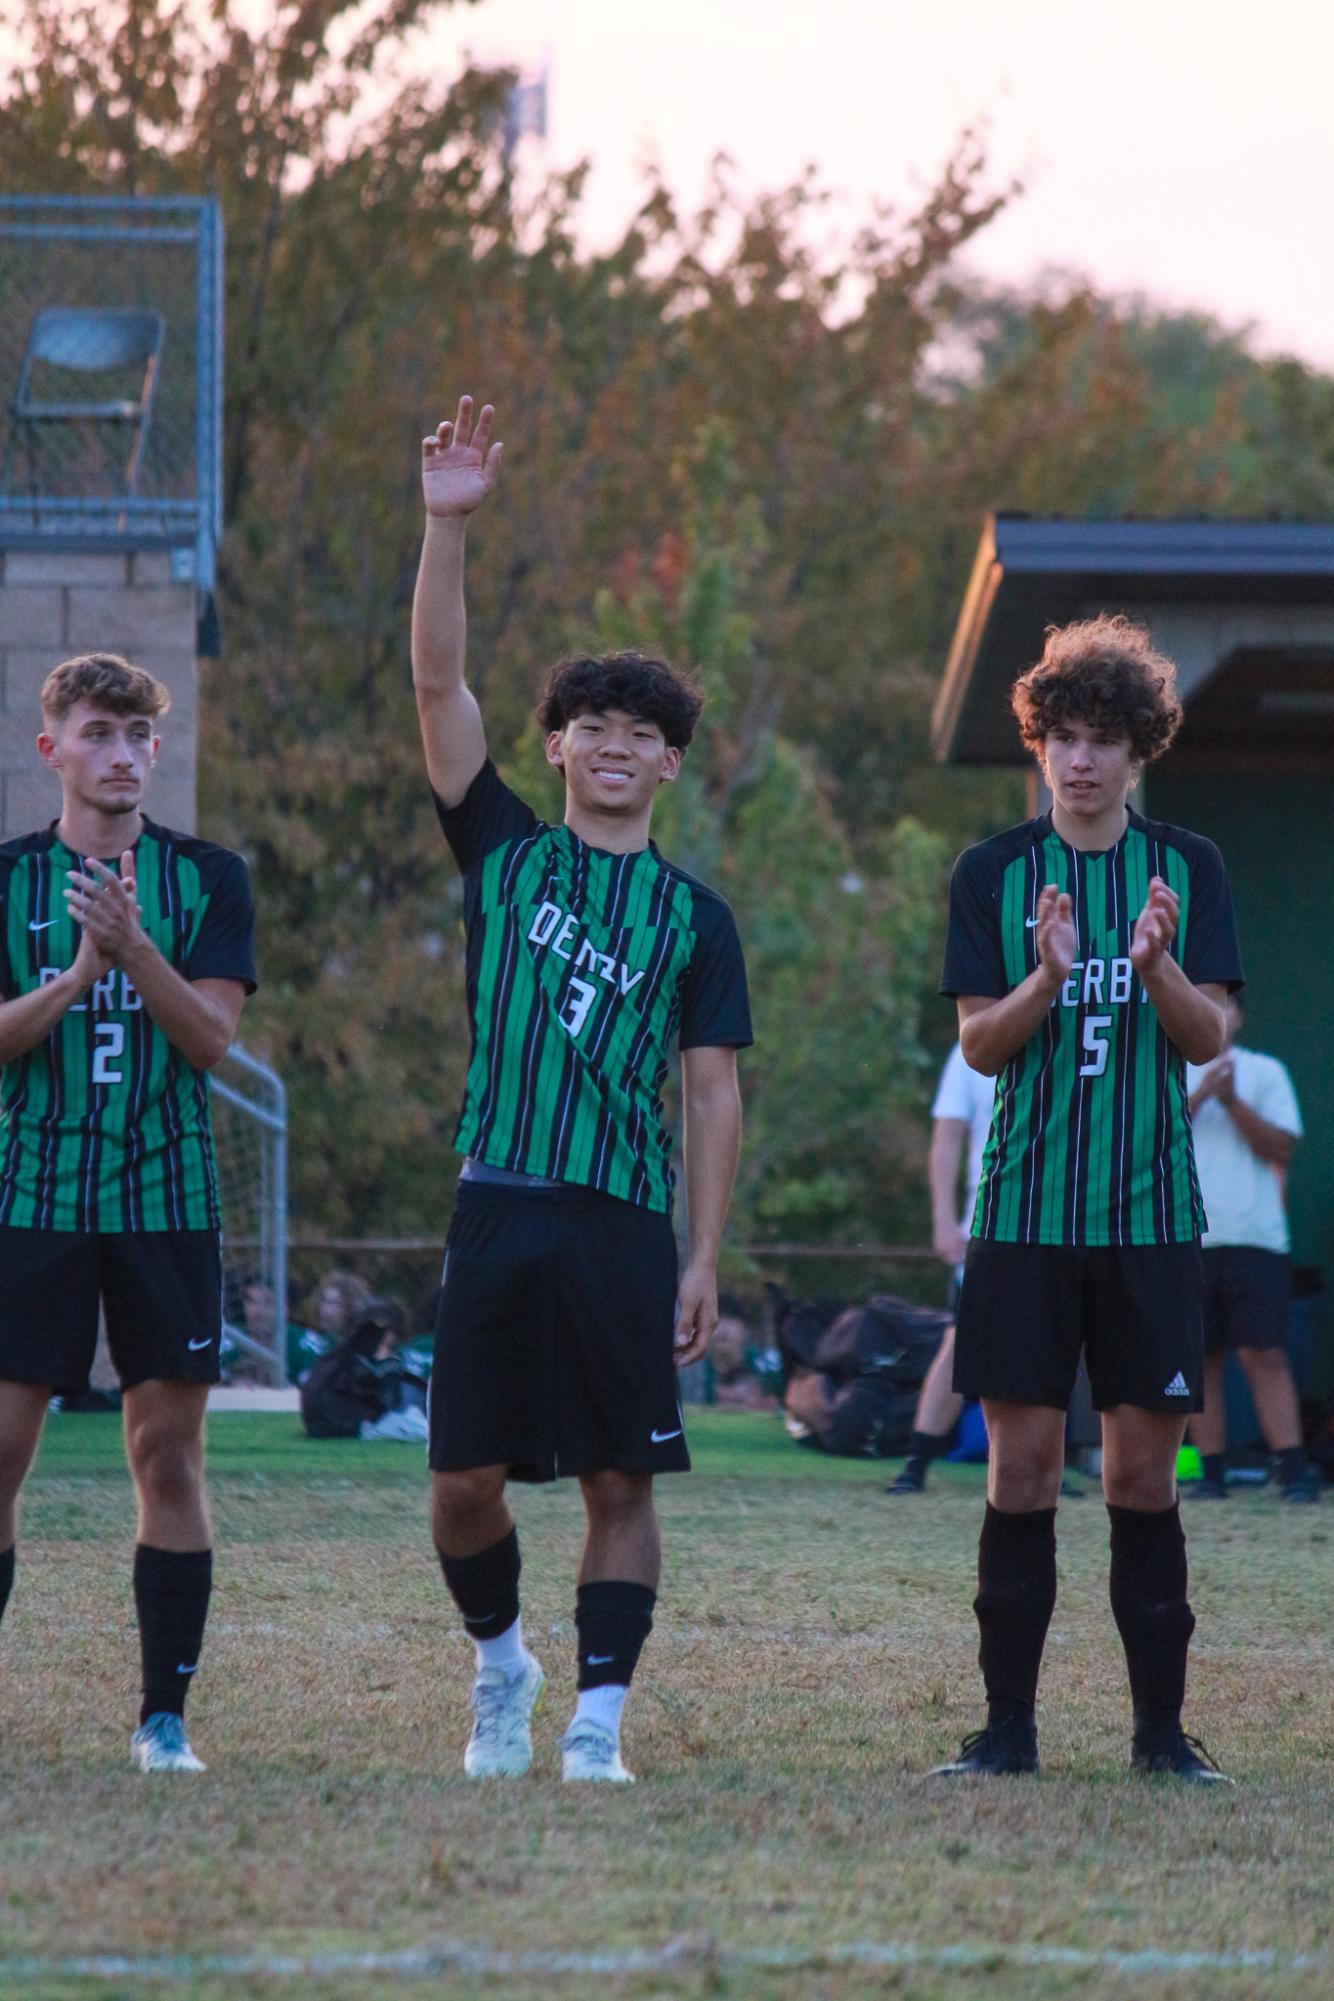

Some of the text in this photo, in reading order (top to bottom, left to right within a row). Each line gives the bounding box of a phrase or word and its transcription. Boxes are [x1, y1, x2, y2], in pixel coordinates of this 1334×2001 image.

[558, 976, 597, 1038] 3
[1037, 957, 1149, 1008] ERB
[92, 1023, 124, 1083] 2
[1080, 1015, 1112, 1076] 5
